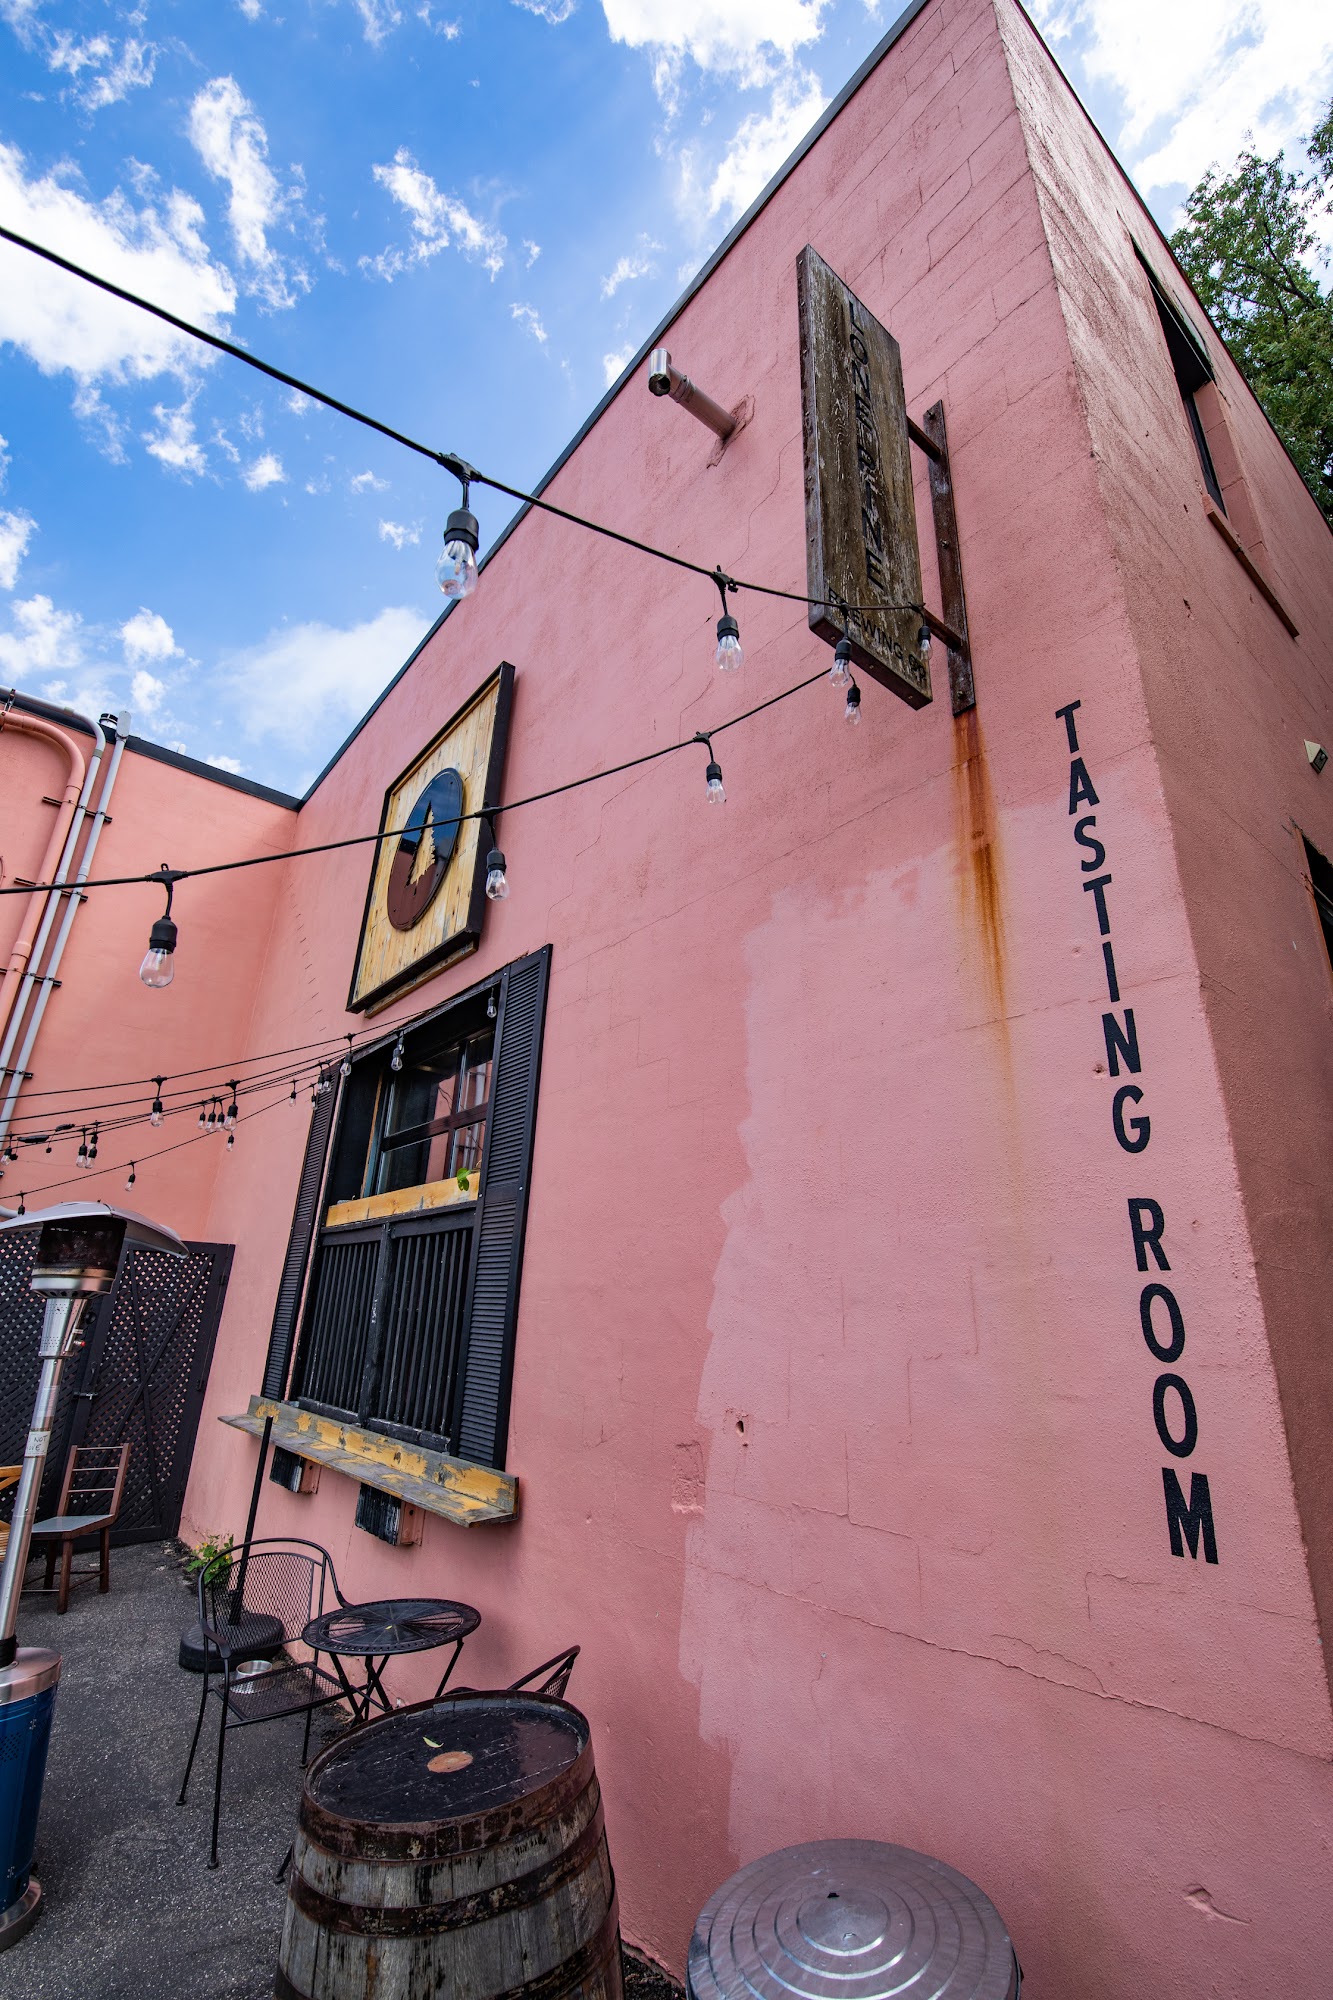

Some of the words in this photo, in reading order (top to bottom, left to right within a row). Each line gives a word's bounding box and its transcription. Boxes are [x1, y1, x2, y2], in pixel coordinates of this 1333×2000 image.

[850, 300, 873, 431] LONE
[828, 586, 903, 660] BEWING
[1055, 699, 1151, 1154] TASTING
[1127, 1197, 1219, 1565] ROOM
